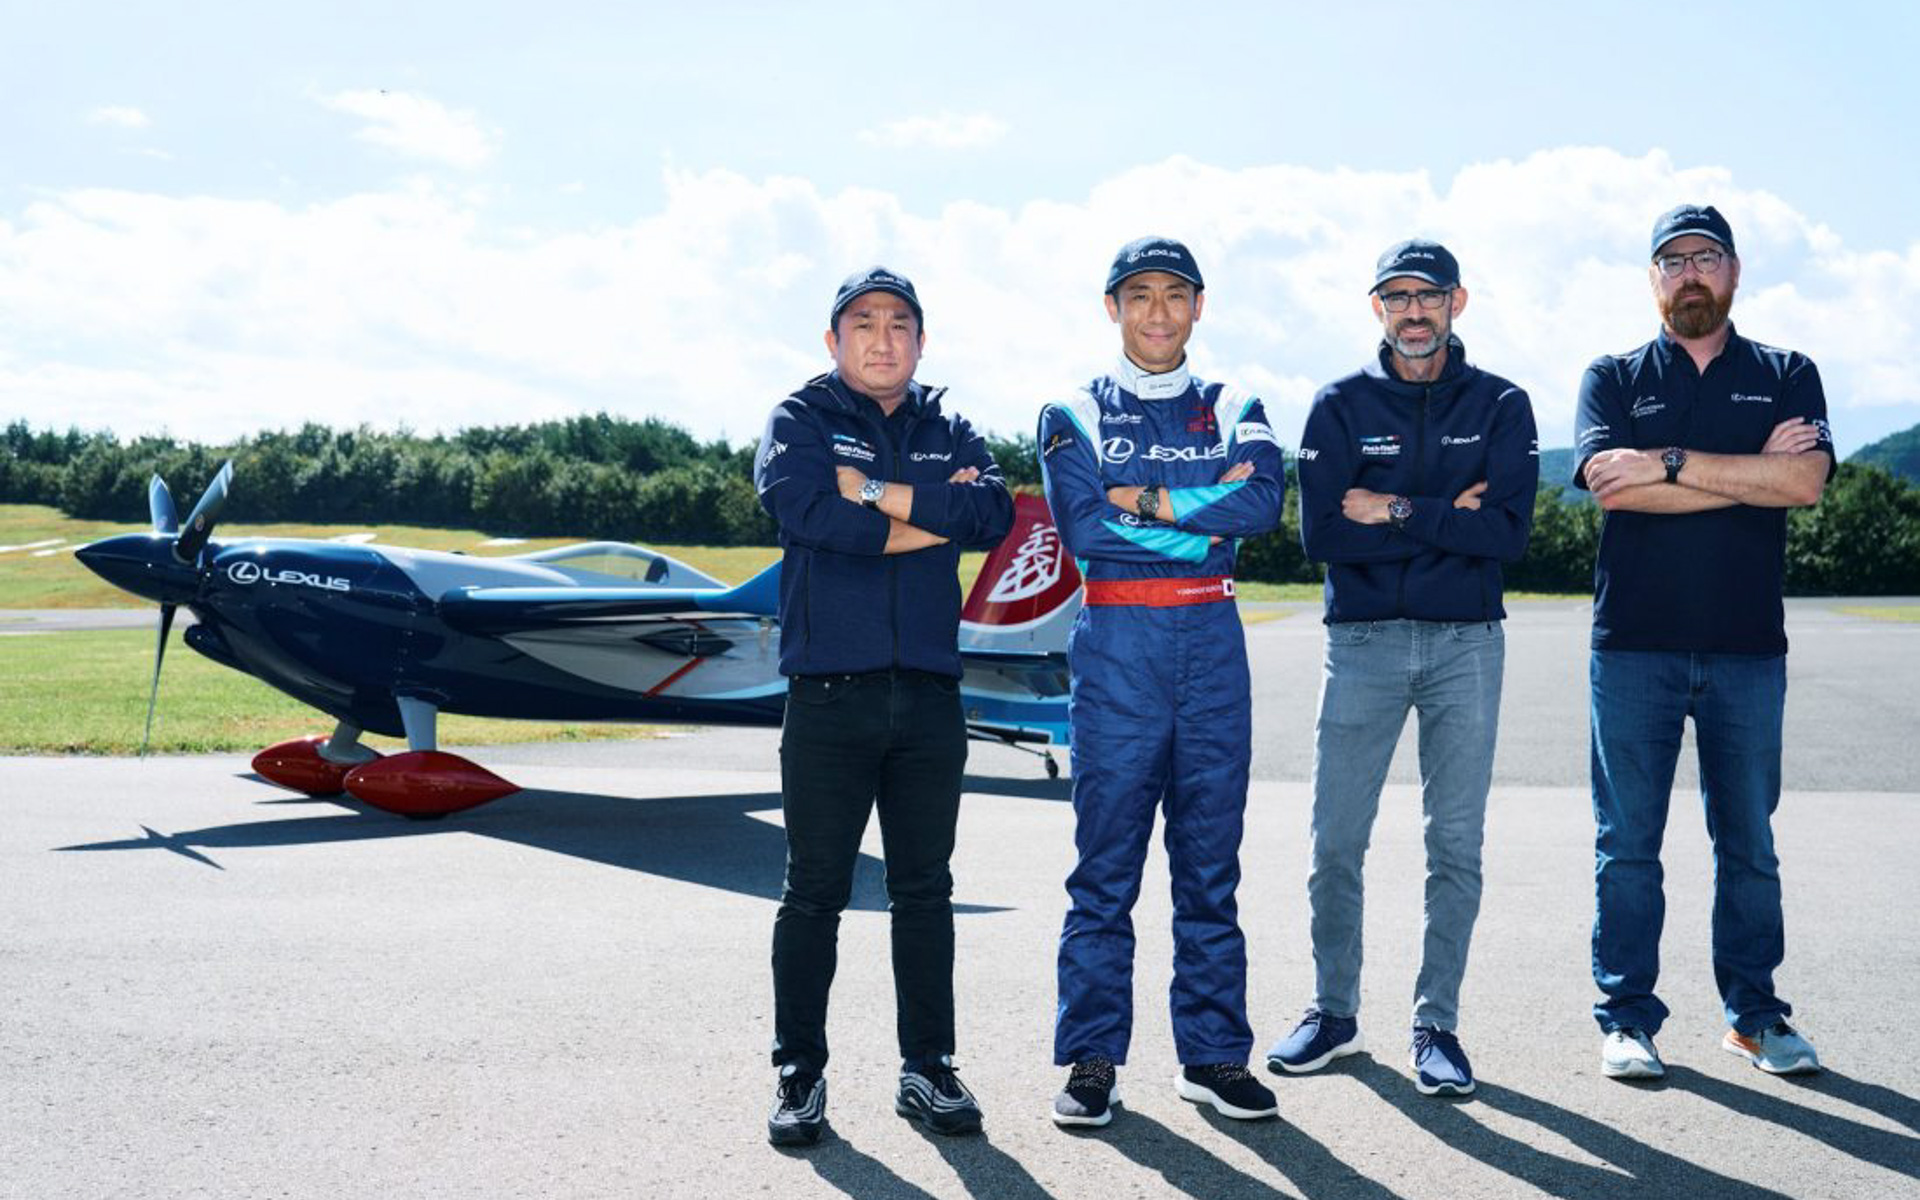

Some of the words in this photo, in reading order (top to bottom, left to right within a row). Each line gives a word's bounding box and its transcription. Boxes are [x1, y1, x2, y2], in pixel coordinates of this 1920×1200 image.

[1141, 249, 1181, 260] LEXUS
[762, 441, 788, 468] CREW
[263, 567, 350, 592] LEXUS
